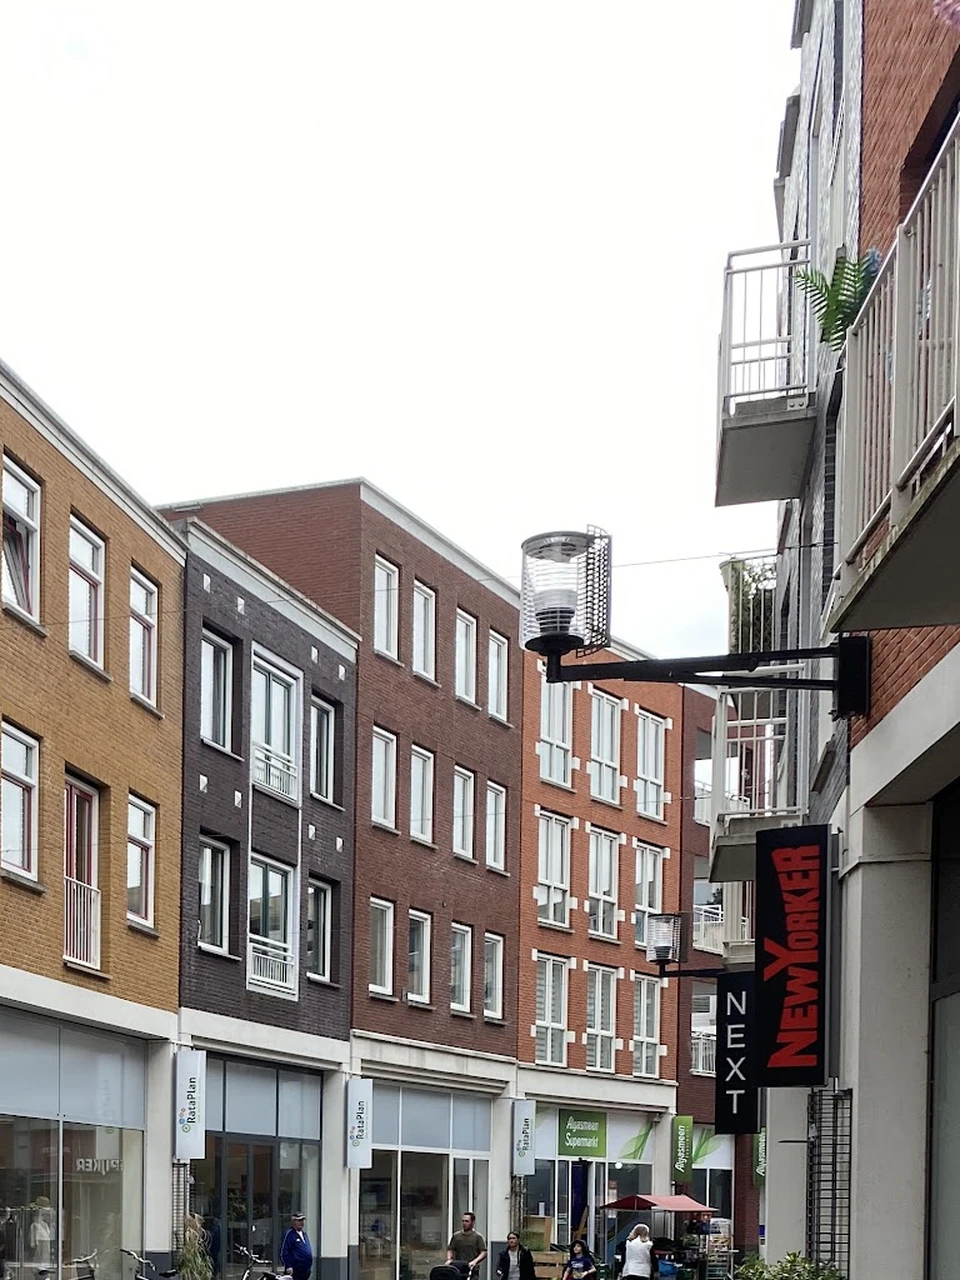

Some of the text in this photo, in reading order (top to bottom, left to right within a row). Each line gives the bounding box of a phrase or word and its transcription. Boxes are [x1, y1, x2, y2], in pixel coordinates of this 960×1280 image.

[726, 991, 747, 1114] NEXT
[186, 1076, 196, 1124] RataPlan
[355, 1100, 365, 1140] RataPlan
[522, 1118, 530, 1151] RataPlan
